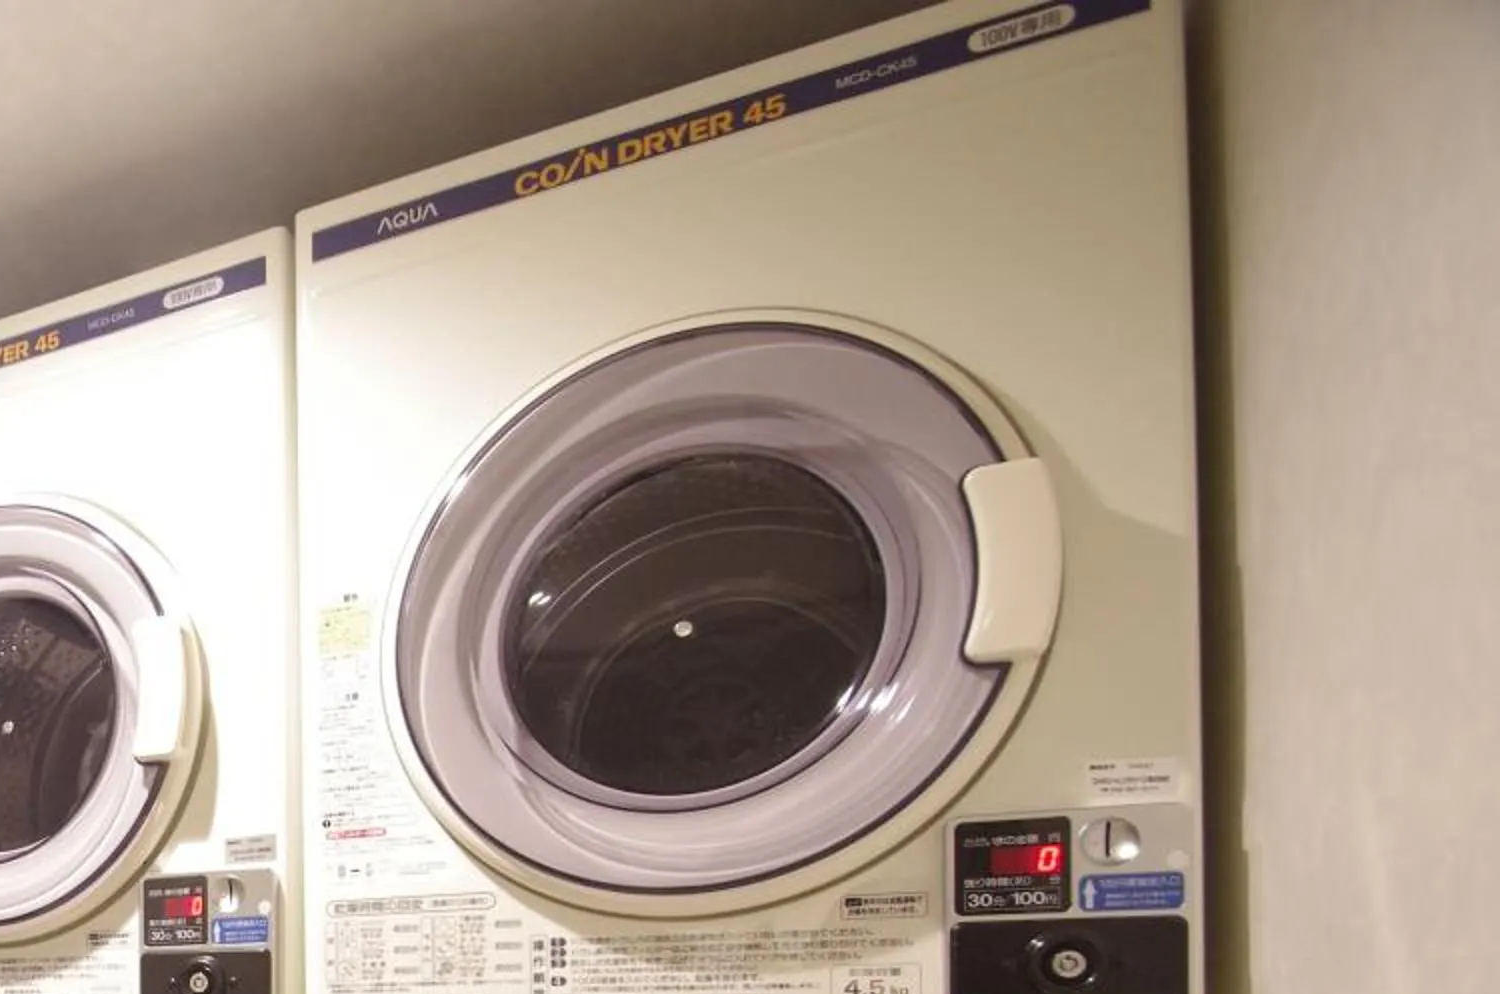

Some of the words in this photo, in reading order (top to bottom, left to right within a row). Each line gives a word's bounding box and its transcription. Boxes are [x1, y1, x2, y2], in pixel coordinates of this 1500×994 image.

[377, 203, 438, 235] AQUA
[617, 111, 733, 165] DRYER
[743, 94, 786, 125] 45
[35, 329, 61, 353] 45
[1037, 847, 1060, 872] 0
